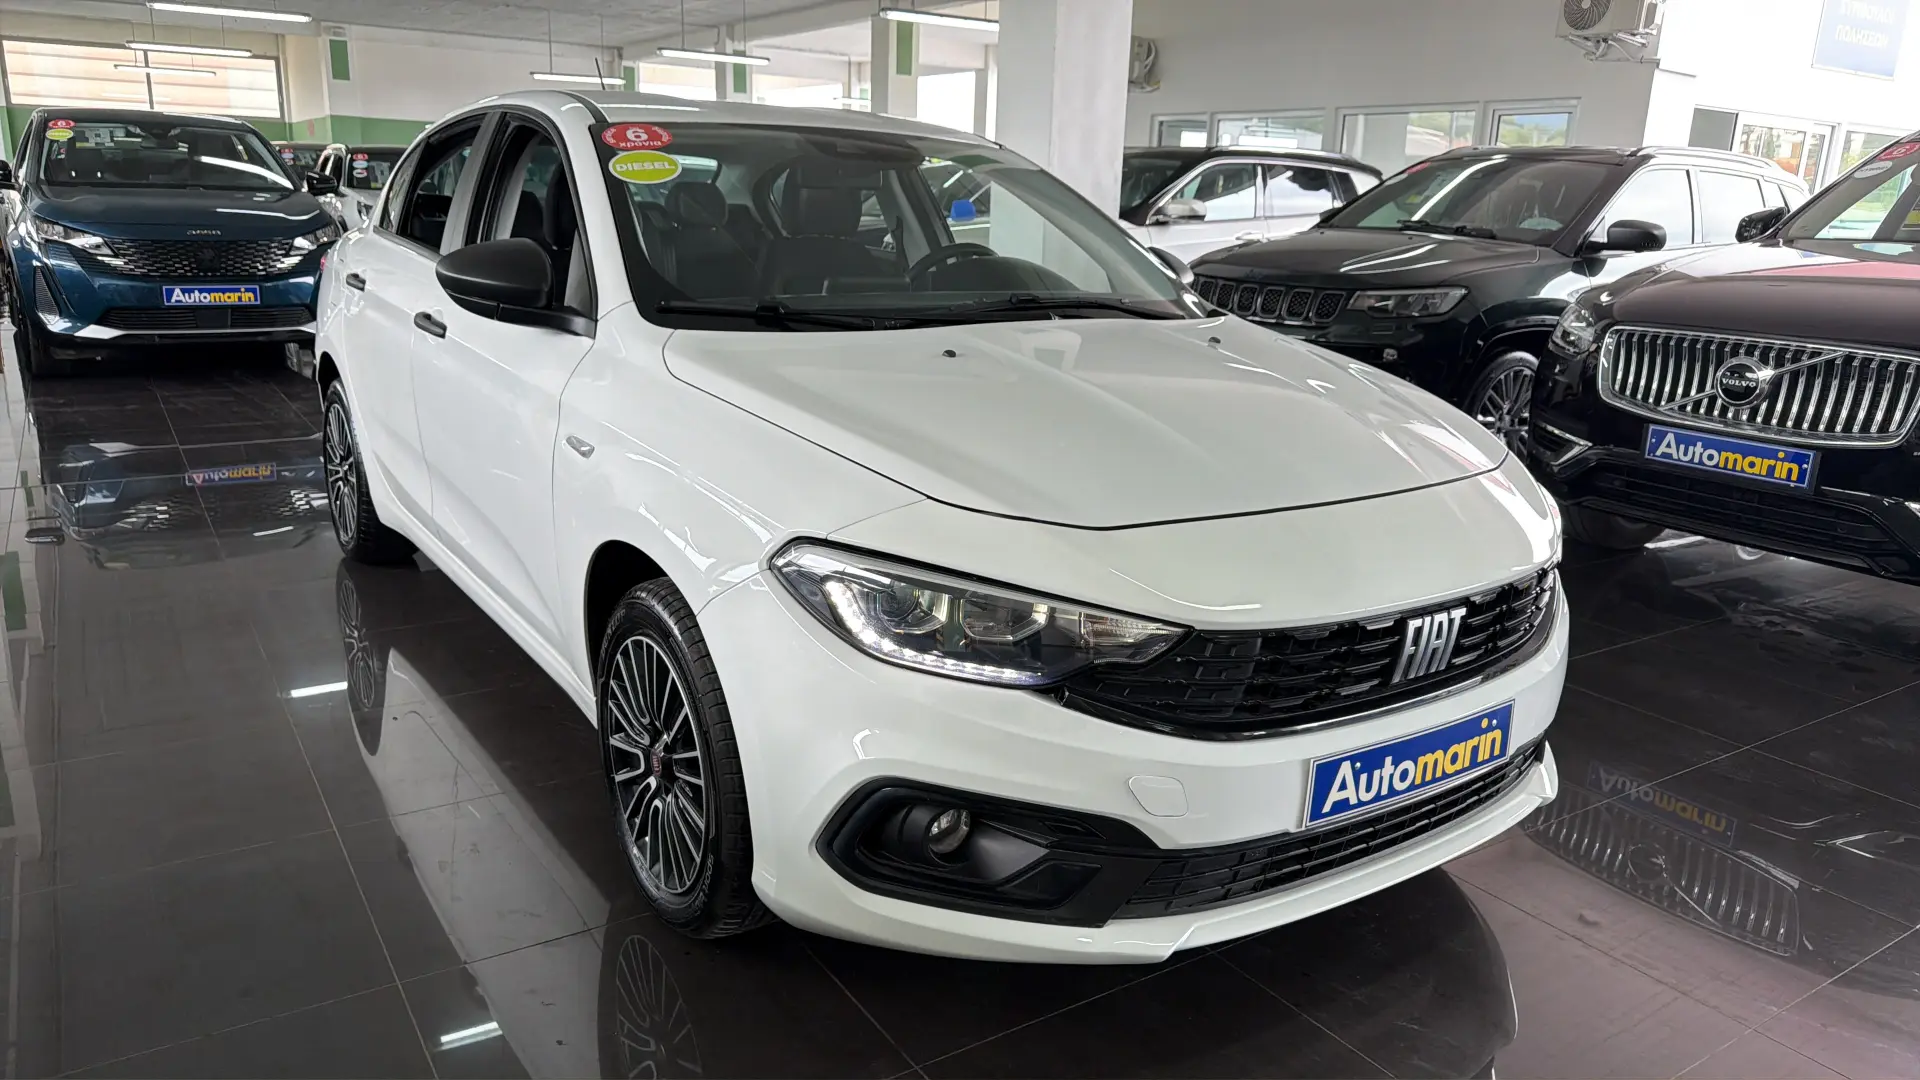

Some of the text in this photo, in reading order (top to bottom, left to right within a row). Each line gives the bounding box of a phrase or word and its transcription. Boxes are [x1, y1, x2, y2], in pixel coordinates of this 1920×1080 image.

[625, 129, 649, 141] 6
[615, 161, 675, 171] DIESEL
[170, 287, 255, 303] Automarin
[1722, 378, 1756, 388] VOLVO
[1655, 432, 1799, 481] Automarin
[1390, 607, 1467, 685] FIAT
[1321, 717, 1502, 814] Automarin
